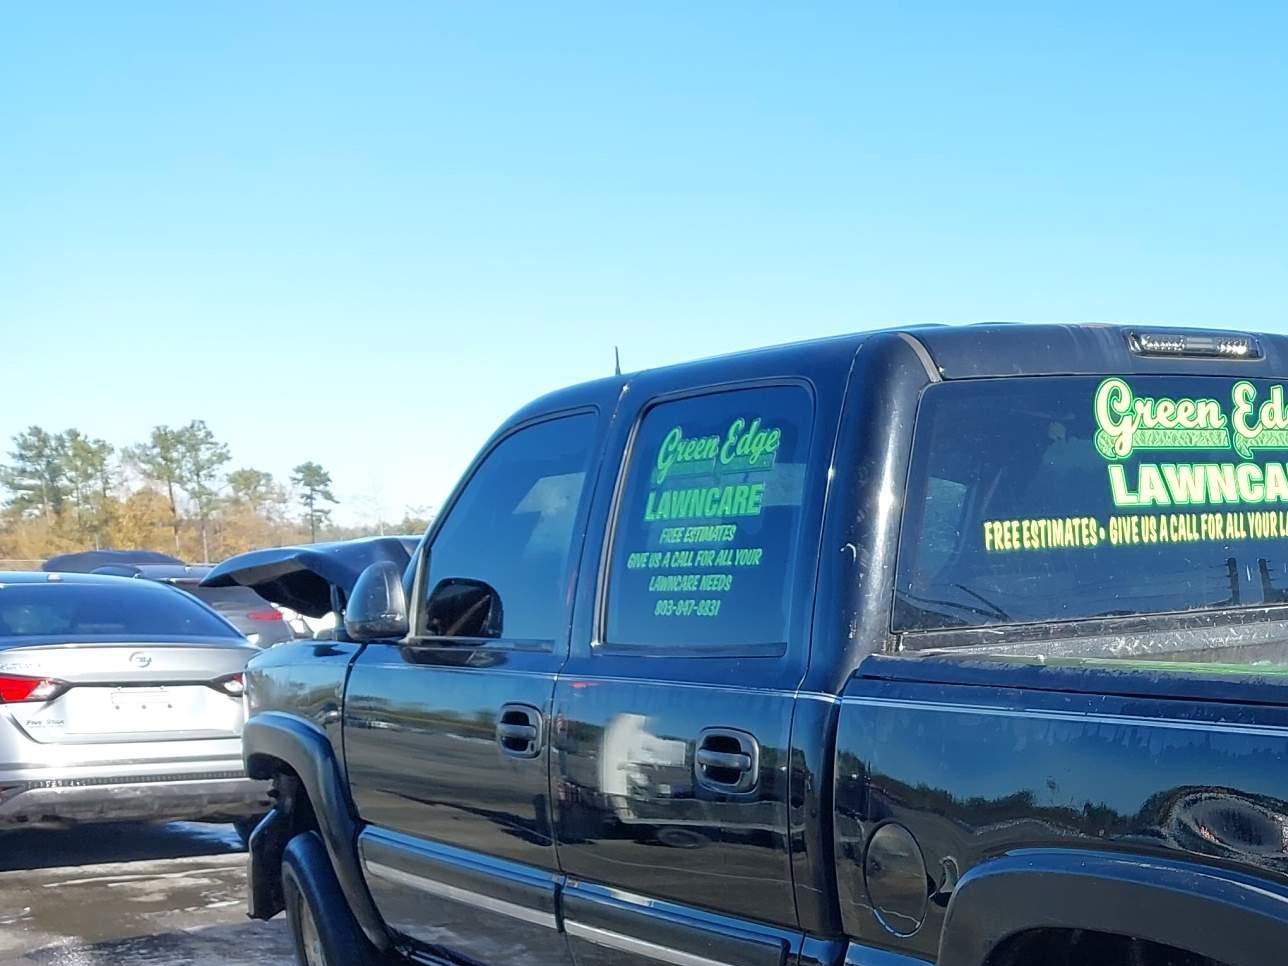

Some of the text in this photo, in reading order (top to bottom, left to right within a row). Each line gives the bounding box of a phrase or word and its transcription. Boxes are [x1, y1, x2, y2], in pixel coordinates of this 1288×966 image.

[1095, 377, 1227, 457] Green
[657, 417, 782, 484] Green Edge
[644, 482, 766, 521] LAWNCARE
[659, 524, 737, 544] FREE ESTIMATES
[984, 519, 1021, 551] FREE
[1022, 517, 1098, 549] ESTIMATES
[1109, 515, 1140, 545] GIVE
[1140, 515, 1158, 543] US
[1159, 514, 1169, 542] A
[1169, 513, 1200, 542] CALL
[1200, 512, 1225, 541] FOR
[1225, 511, 1247, 539] ALL
[1247, 510, 1279, 538] YOUR
[627, 548, 763, 569] GIVE US A CALL FOR ALL YOUR
[648, 574, 733, 592] LAWNCARE NEEDS
